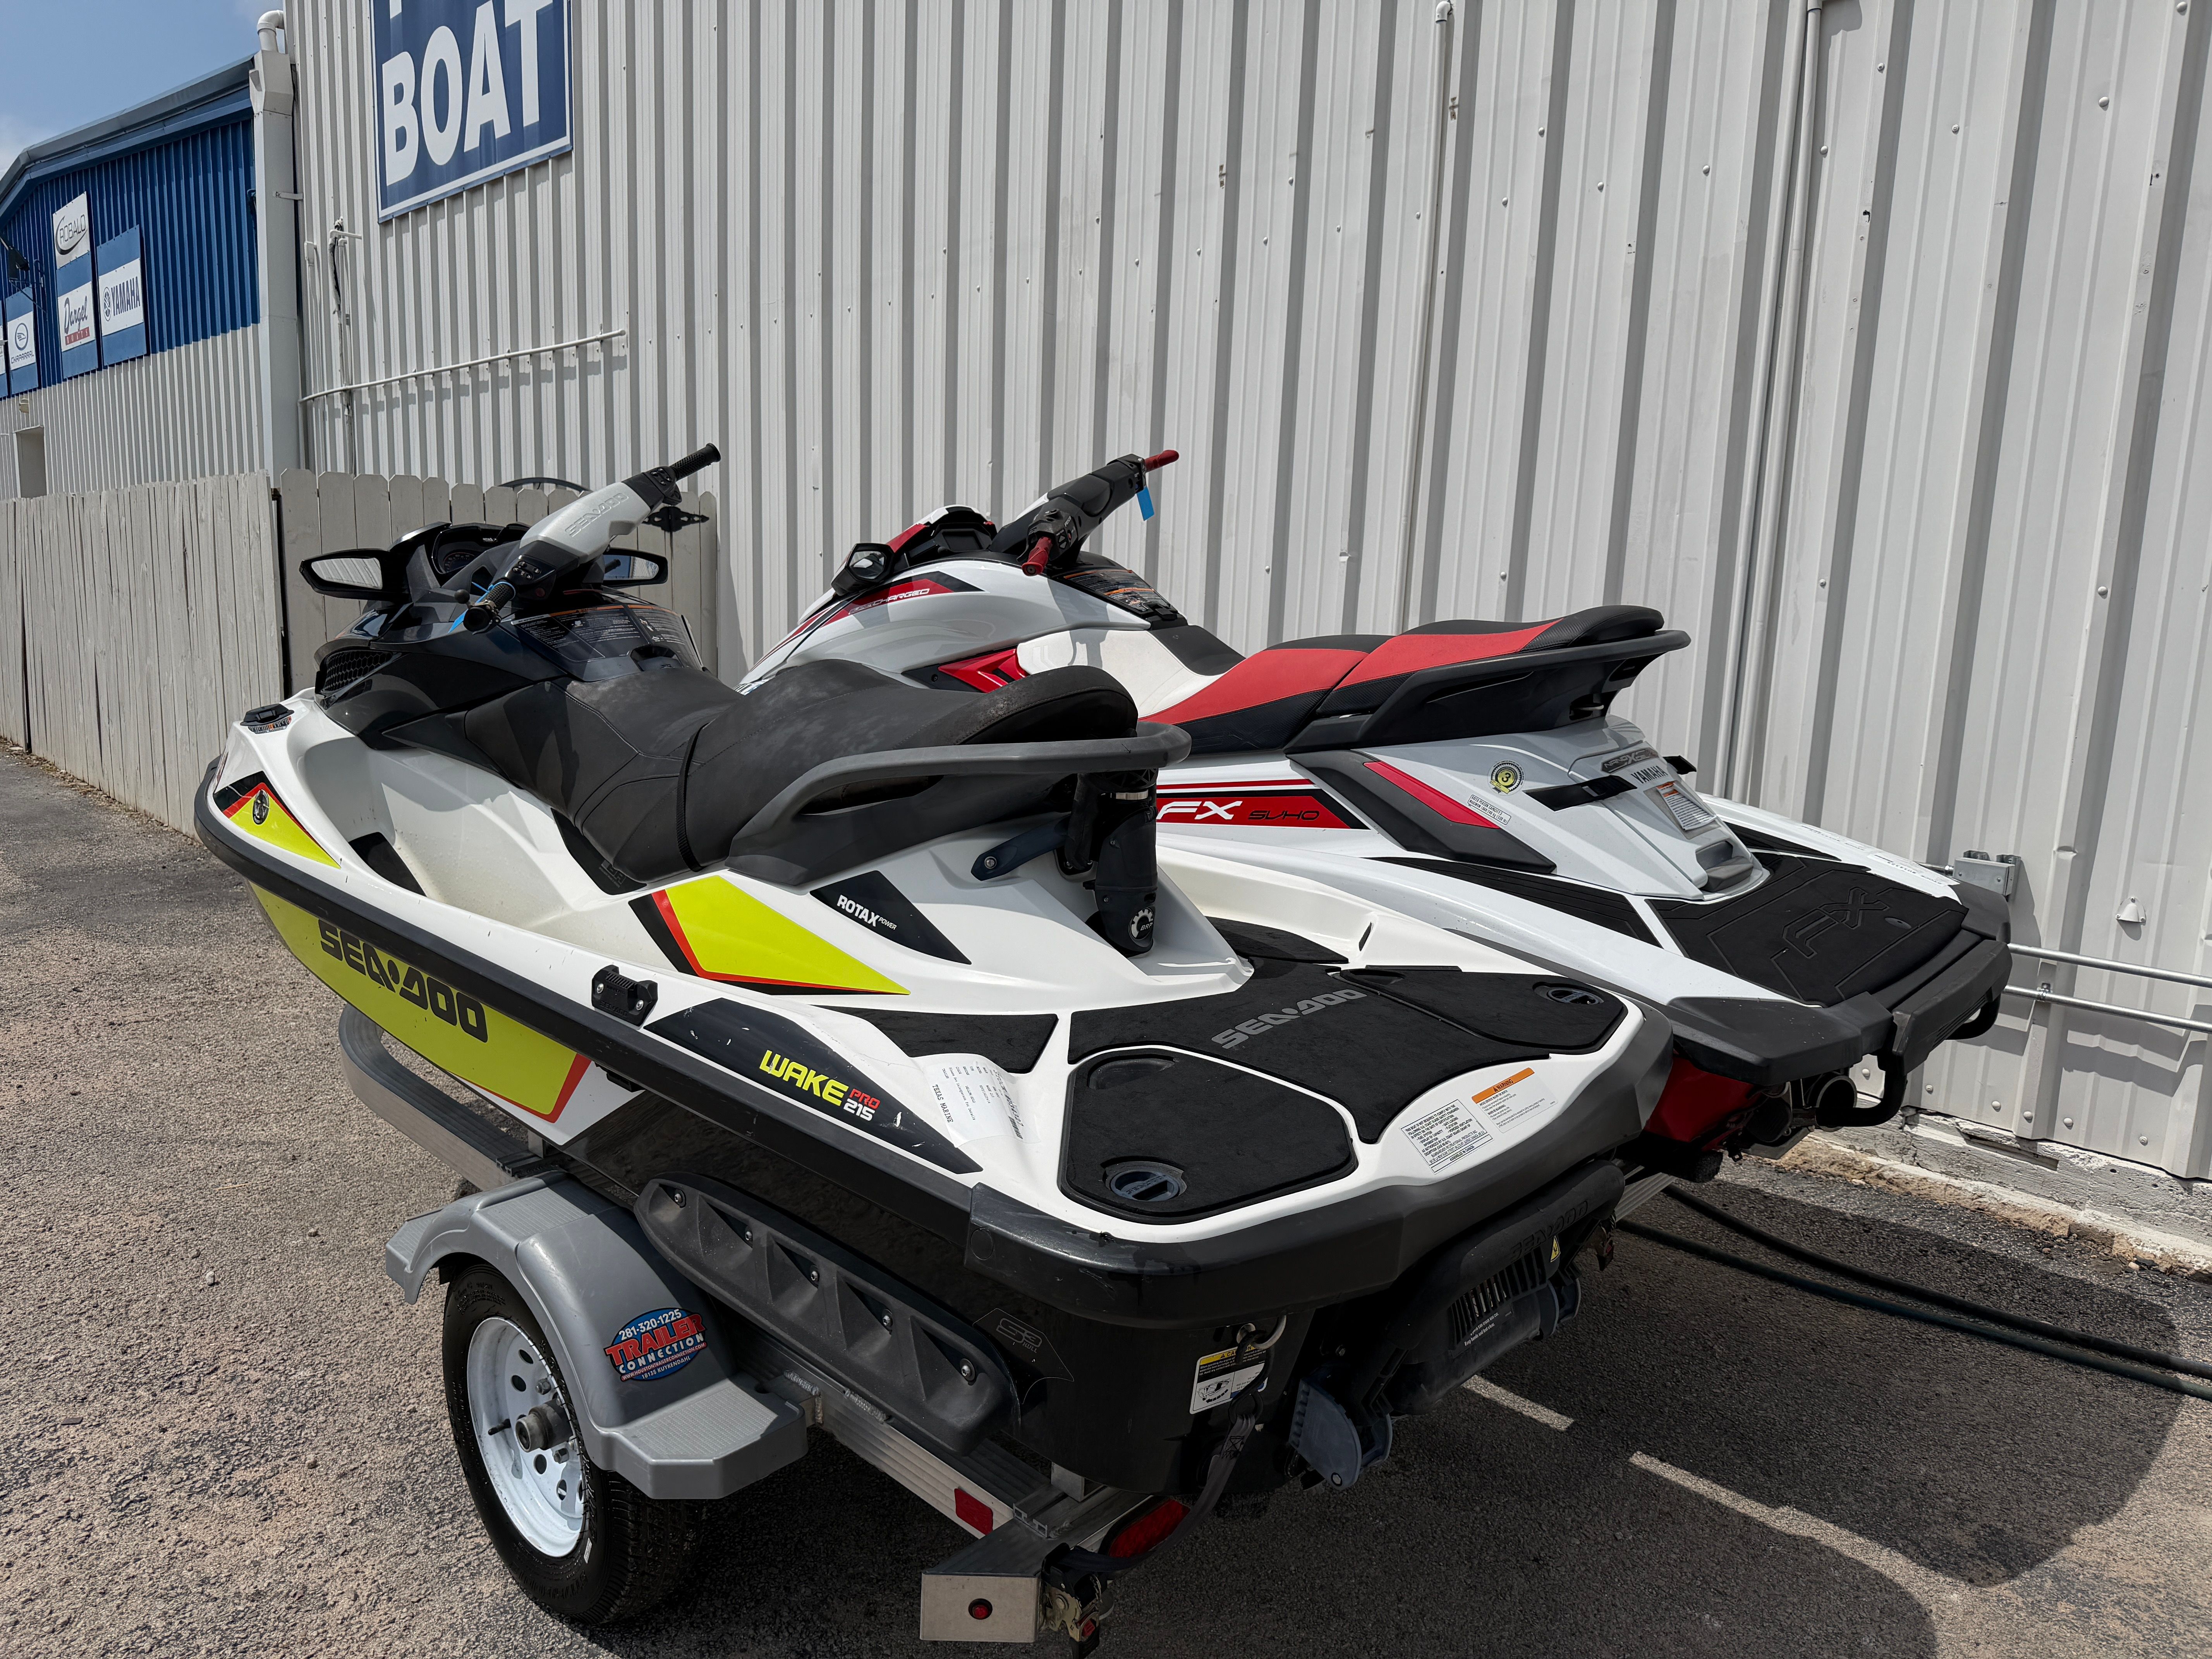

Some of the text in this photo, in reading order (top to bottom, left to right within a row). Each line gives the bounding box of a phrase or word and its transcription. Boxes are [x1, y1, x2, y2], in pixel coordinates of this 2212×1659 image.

[382, 0, 553, 186] BOAT
[59, 213, 86, 246] ROBALO
[111, 276, 140, 317] YAMAHA
[64, 297, 88, 335] Dargel
[1502, 773, 1511, 783] 3
[1631, 765, 1668, 784] YAMAHA
[1156, 800, 1320, 821] FX SVHO
[837, 895, 897, 930] ROTAX POWER
[1140, 922, 1153, 931] BRP
[759, 1050, 880, 1109] WAKE PRO
[1496, 1079, 1514, 1090] WARNING
[843, 1098, 875, 1121] 215
[933, 1084, 953, 1123] TEXAS MARINE
[605, 1314, 705, 1365] TRAILER
[619, 1309, 682, 1341] 281-320-1225
[619, 1333, 704, 1374] CONNECTION
[622, 1342, 706, 1380] WWW.HOUSTONTRAILERCONNECTION.COM
[1022, 1341, 1037, 1353] HULL
[641, 1355, 691, 1379] 18135 KUYKENDAHL
